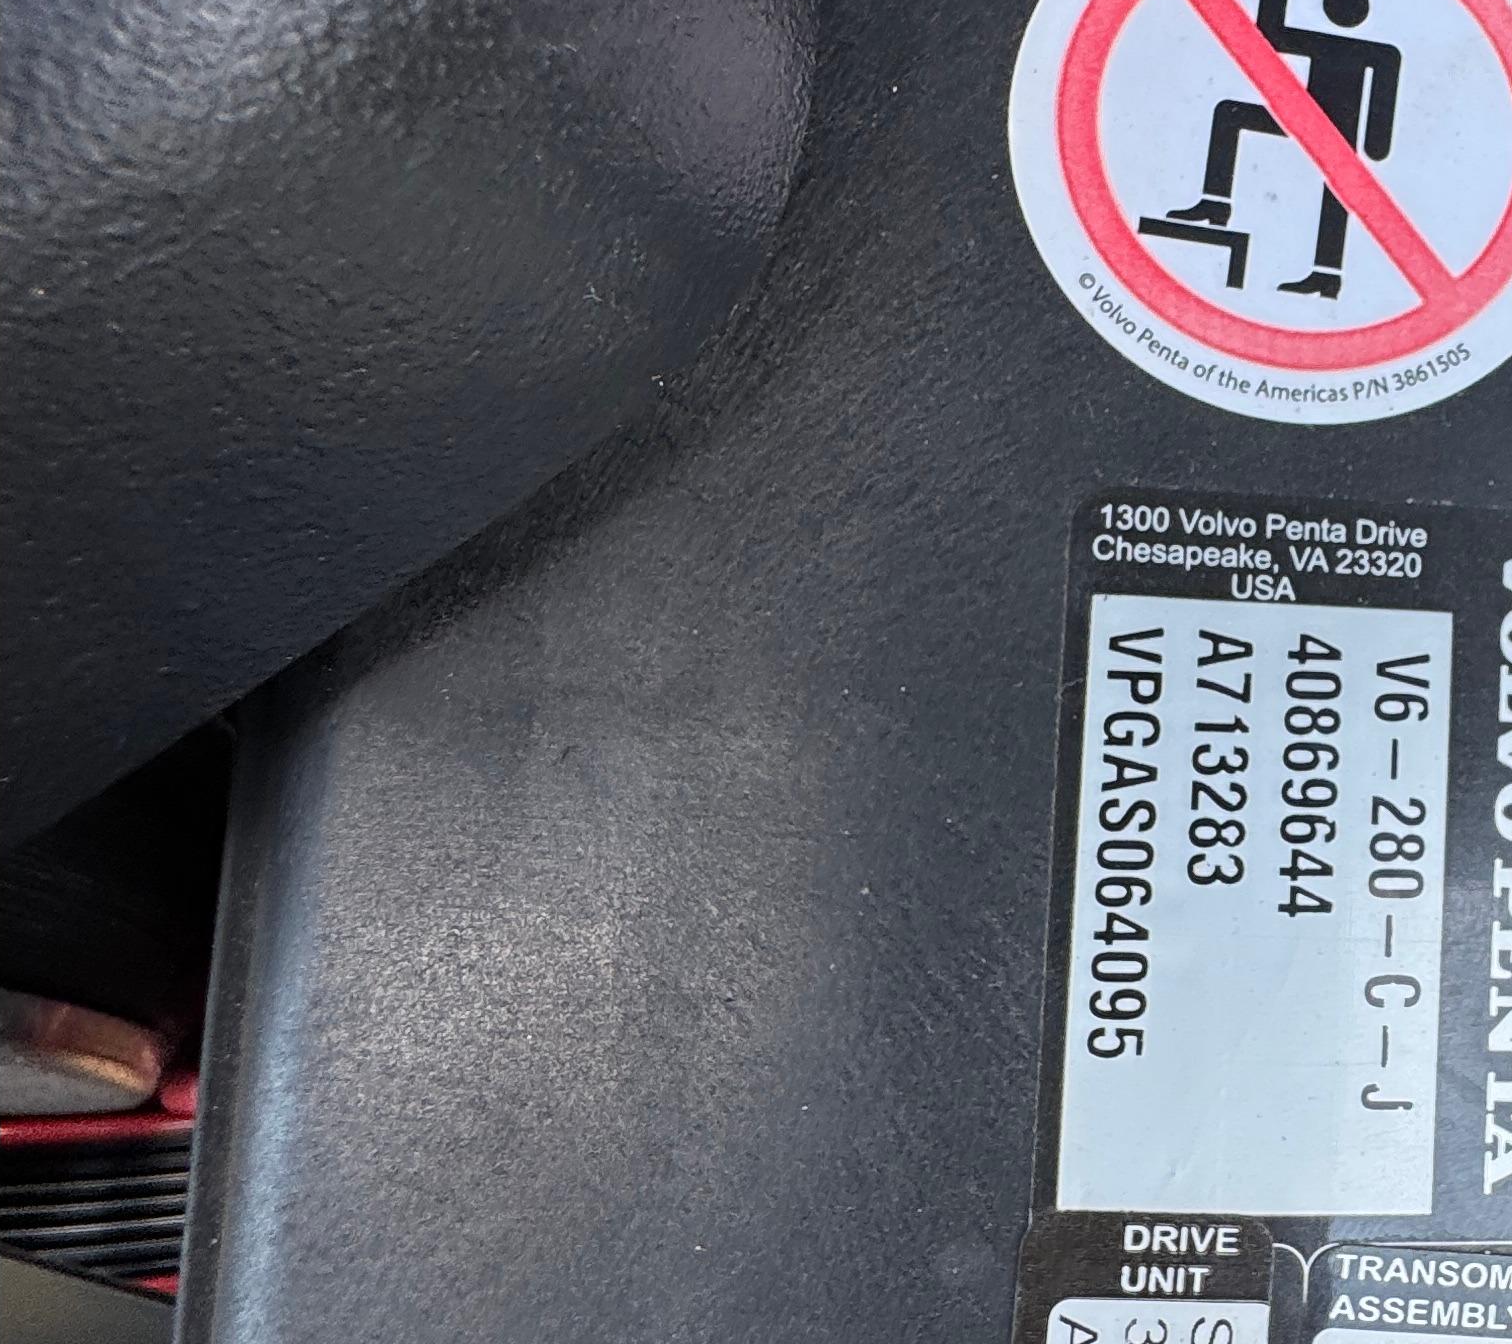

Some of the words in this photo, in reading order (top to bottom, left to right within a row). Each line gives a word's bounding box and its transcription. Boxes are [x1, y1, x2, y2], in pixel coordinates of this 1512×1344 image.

[1092, 285, 1136, 335] Volvo
[1137, 329, 1189, 370] Penta
[1194, 361, 1219, 379] of
[1218, 369, 1252, 394] the
[1255, 380, 1348, 403] Americas
[1353, 376, 1389, 400] P/N
[1393, 343, 1471, 391] 3861505
[1100, 504, 1170, 534] 1300
[1179, 509, 1257, 538] Volvo
[1266, 514, 1348, 543] Penta
[1356, 518, 1429, 548] Drive
[1092, 537, 1280, 572] Chesapeake,
[1289, 547, 1330, 574] VA
[1336, 550, 1423, 578] 23320
[1230, 574, 1296, 602] USA
[1187, 628, 1254, 887] A713283
[1277, 632, 1342, 918] 40869644
[1087, 627, 1165, 1060] VPGAS064095
[1124, 1224, 1240, 1254] DRIVE
[1120, 1266, 1210, 1295] UNIT
